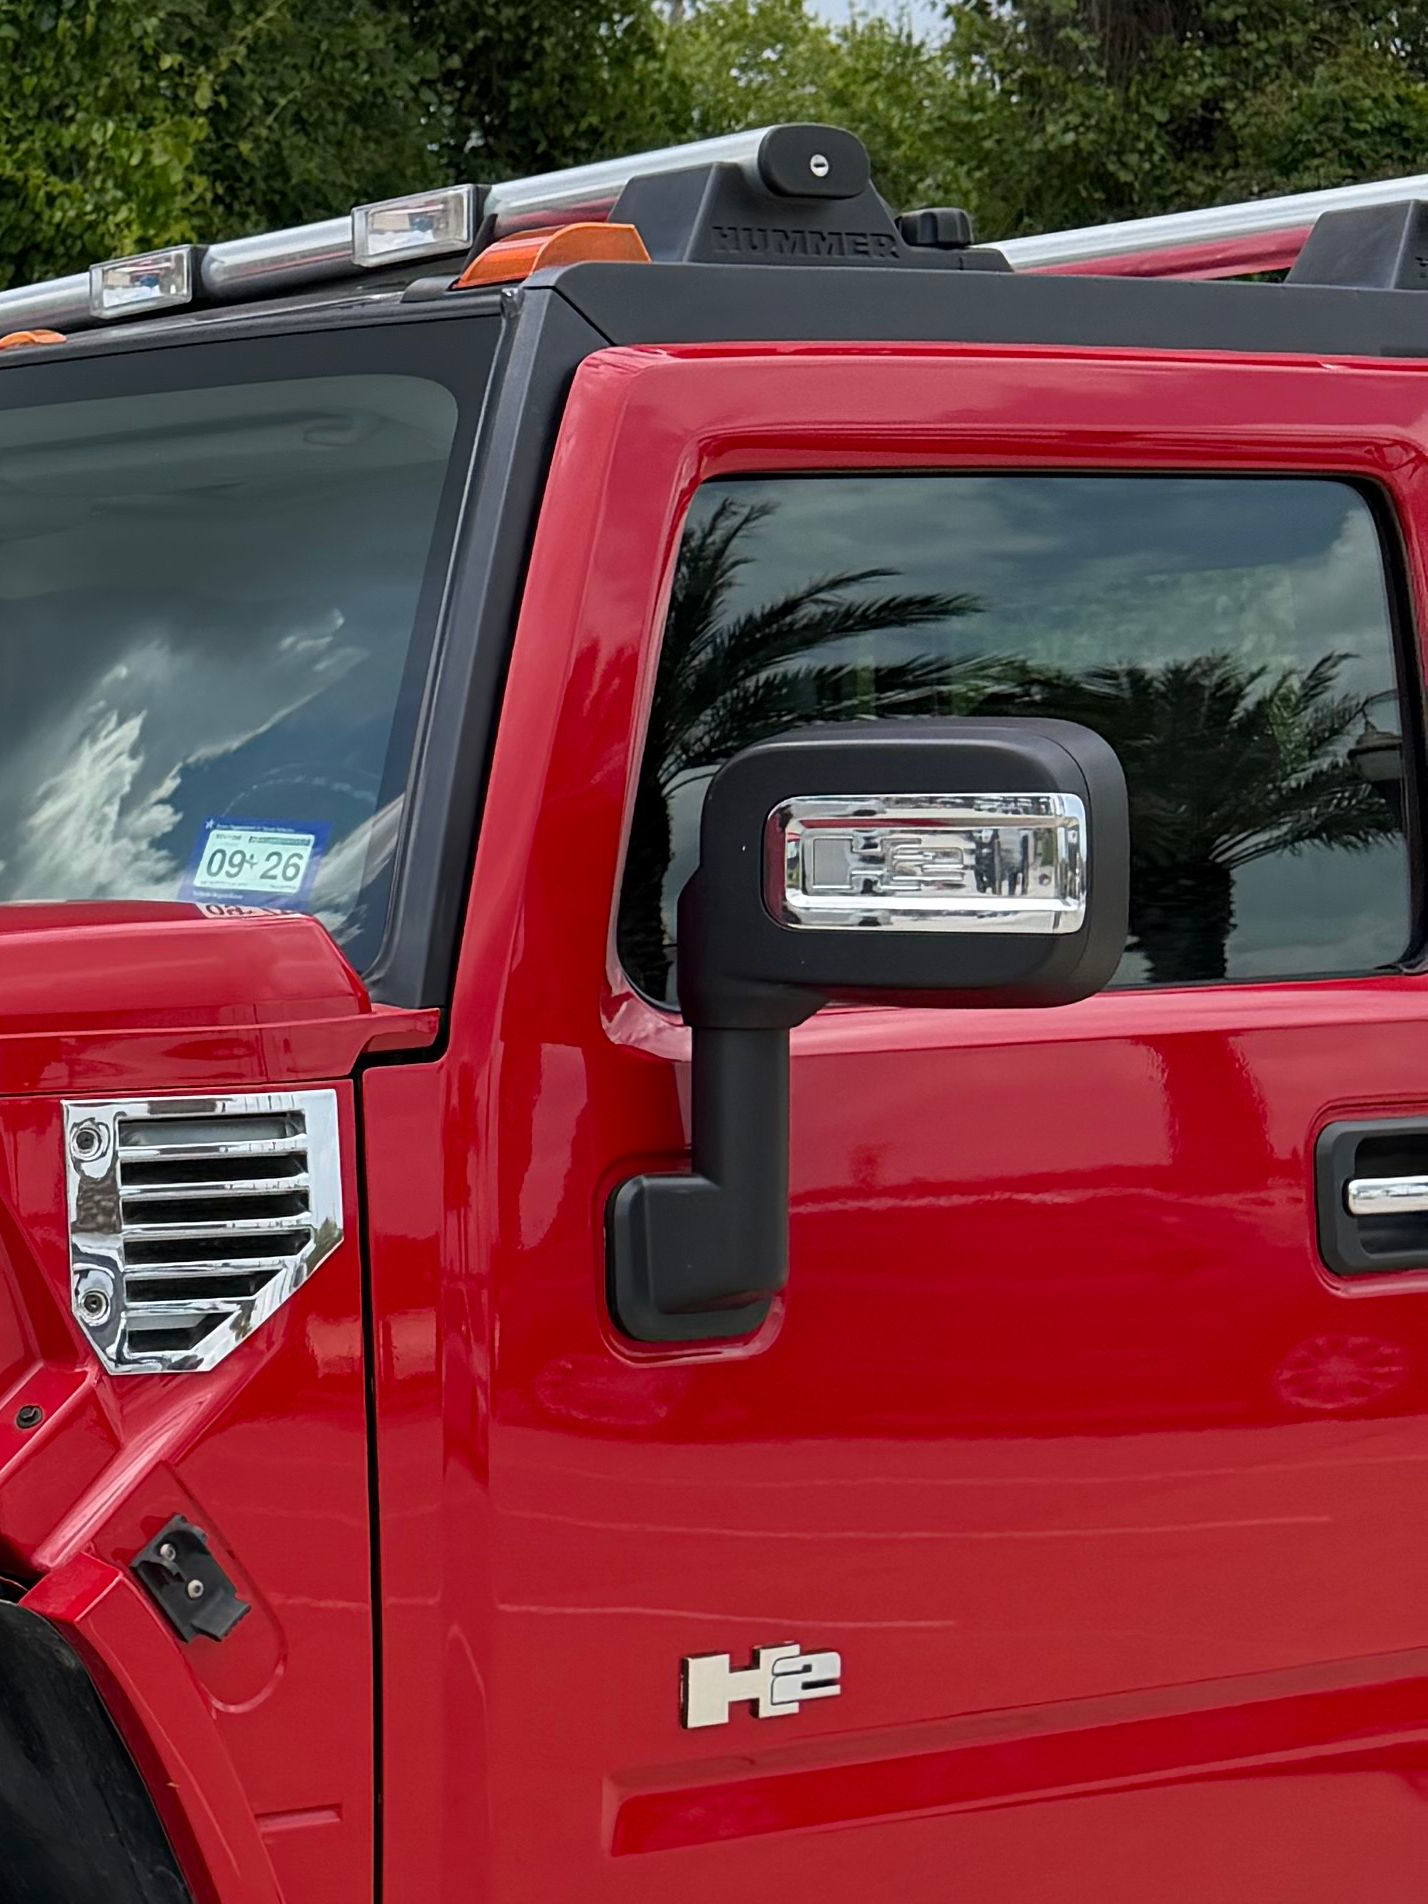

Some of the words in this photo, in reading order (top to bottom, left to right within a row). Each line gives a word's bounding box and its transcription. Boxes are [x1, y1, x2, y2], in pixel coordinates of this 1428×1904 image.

[712, 226, 901, 260] HUMMER
[206, 848, 245, 879] 09
[260, 850, 304, 883] 26
[812, 837, 964, 891] H2
[680, 1642, 842, 1730] H2
